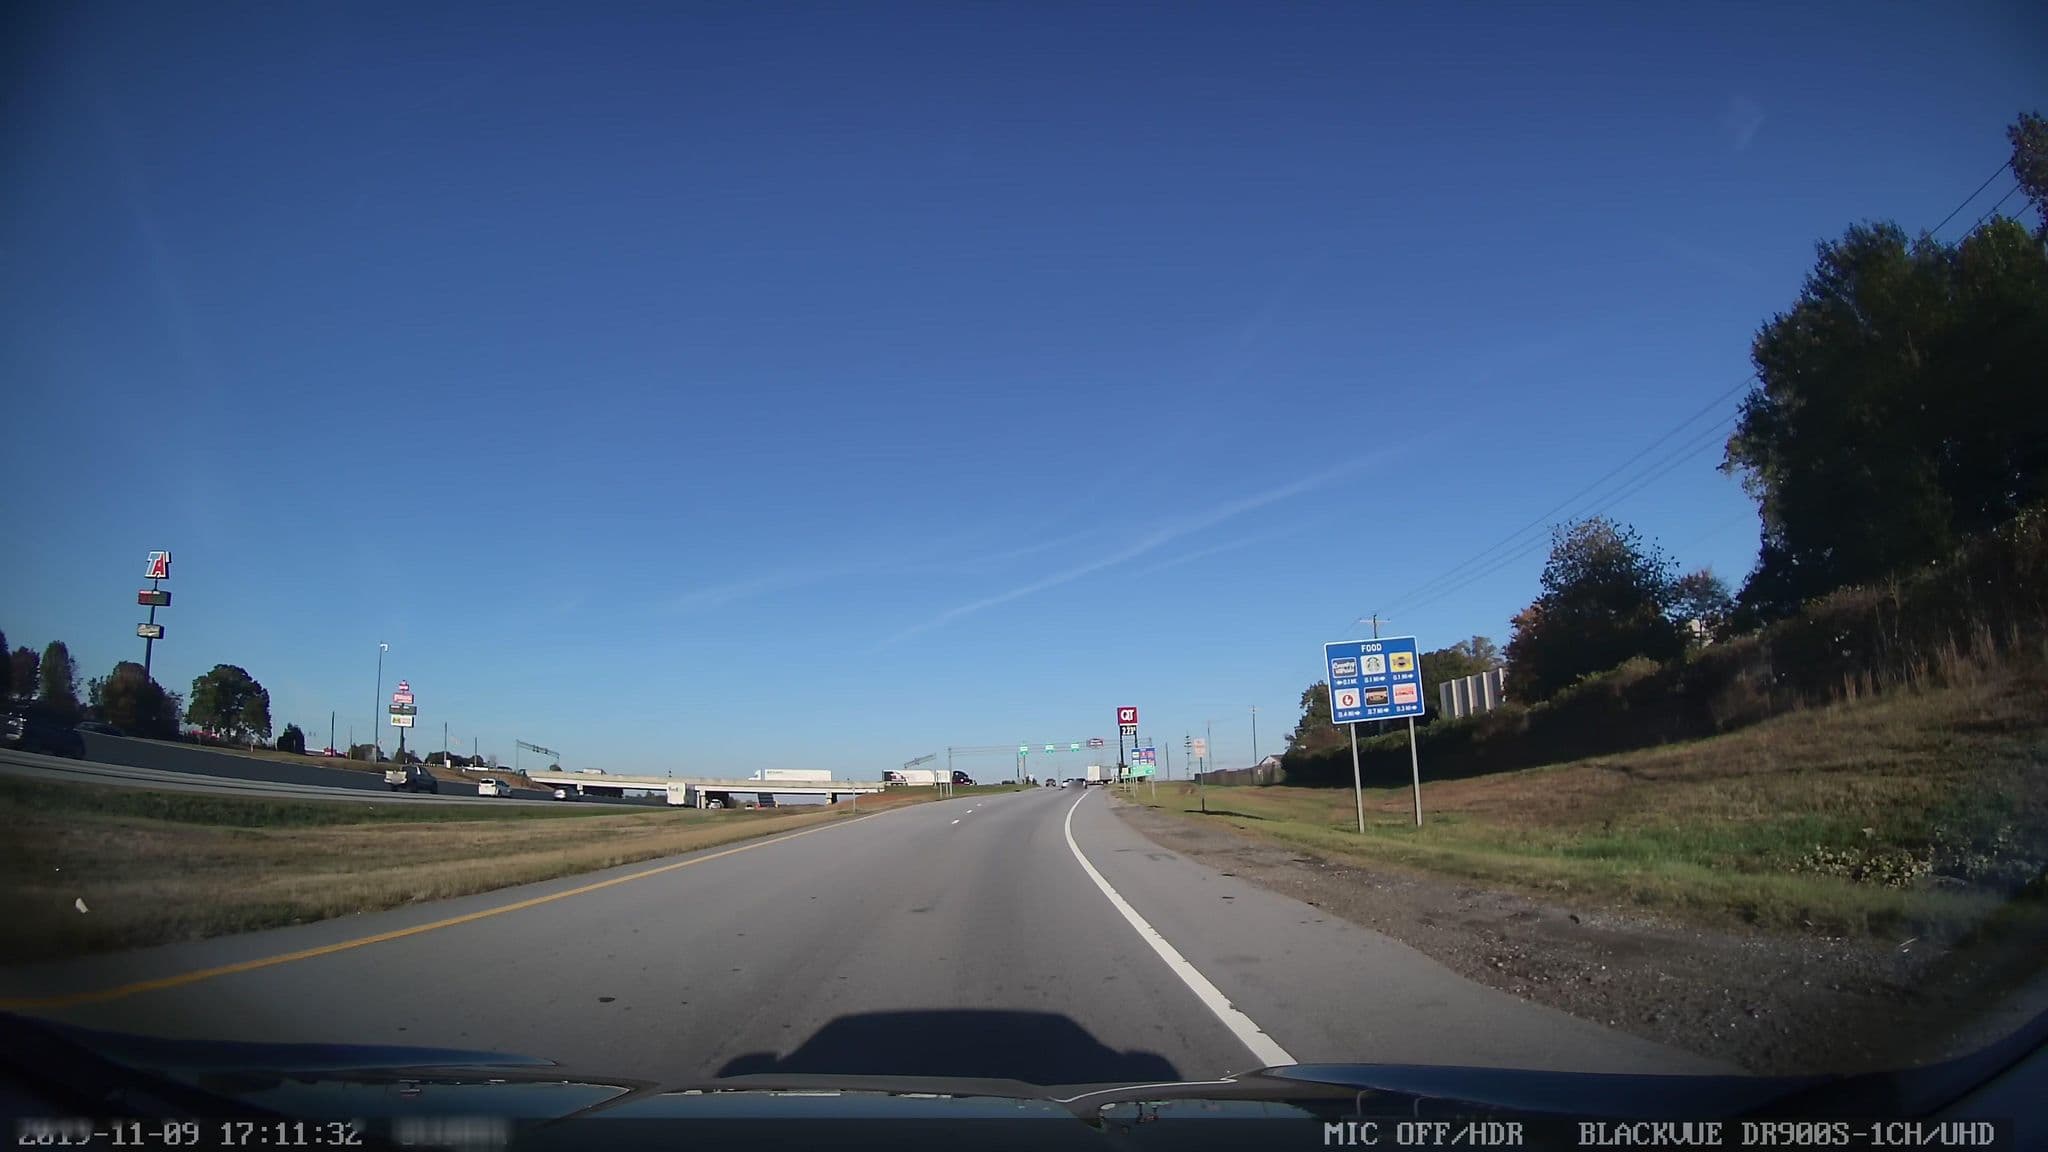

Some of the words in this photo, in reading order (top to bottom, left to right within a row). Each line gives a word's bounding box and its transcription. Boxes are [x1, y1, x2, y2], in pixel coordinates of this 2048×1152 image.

[145, 550, 170, 578] TA
[1361, 643, 1382, 653] FOOD
[1120, 709, 1134, 722] QT
